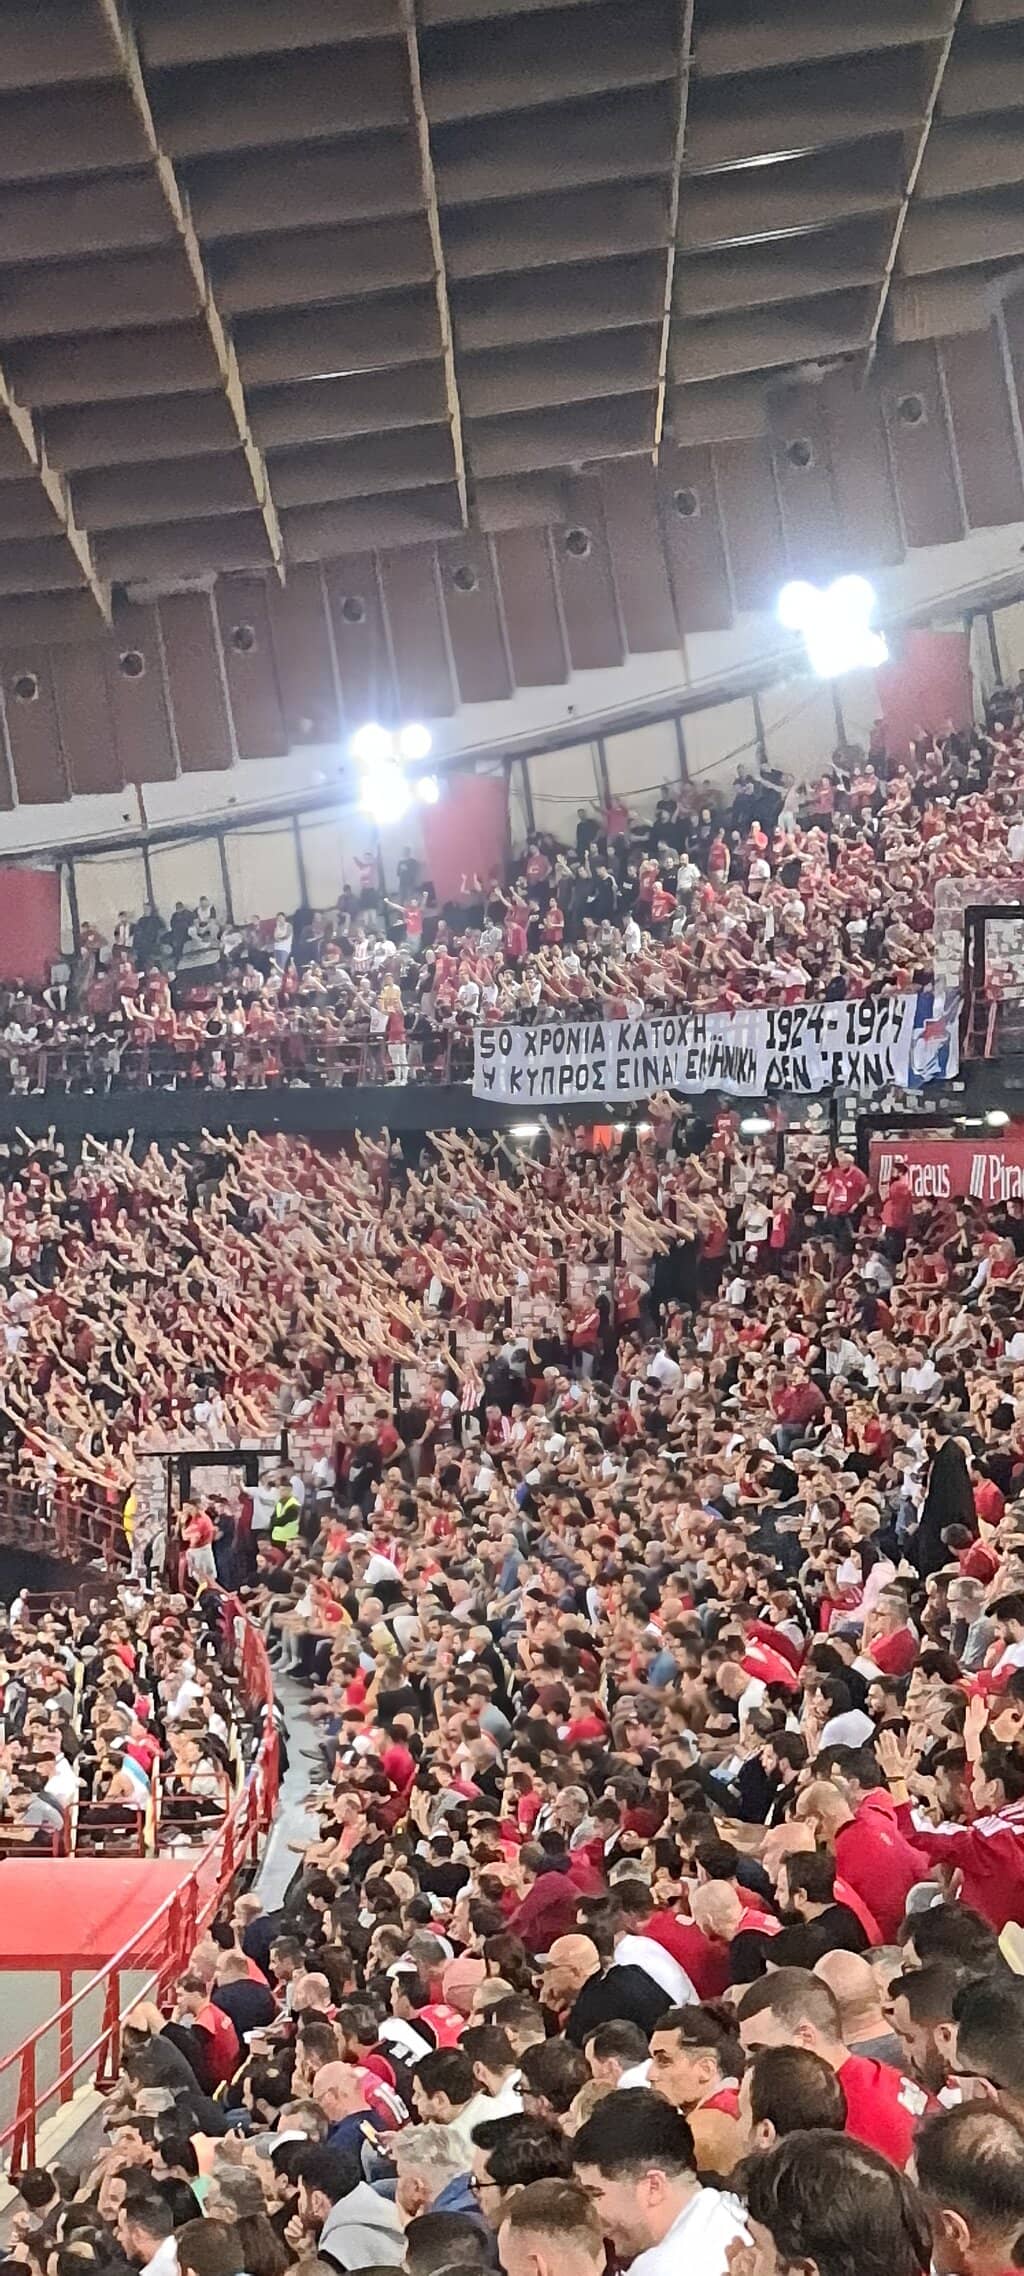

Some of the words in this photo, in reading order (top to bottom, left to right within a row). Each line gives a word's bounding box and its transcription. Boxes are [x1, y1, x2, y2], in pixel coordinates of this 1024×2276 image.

[480, 1029, 513, 1059] 50
[524, 1023, 606, 1057] ΧΡΟΝΙΑ
[510, 1059, 607, 1096] ΚΥΠΡΟΣ
